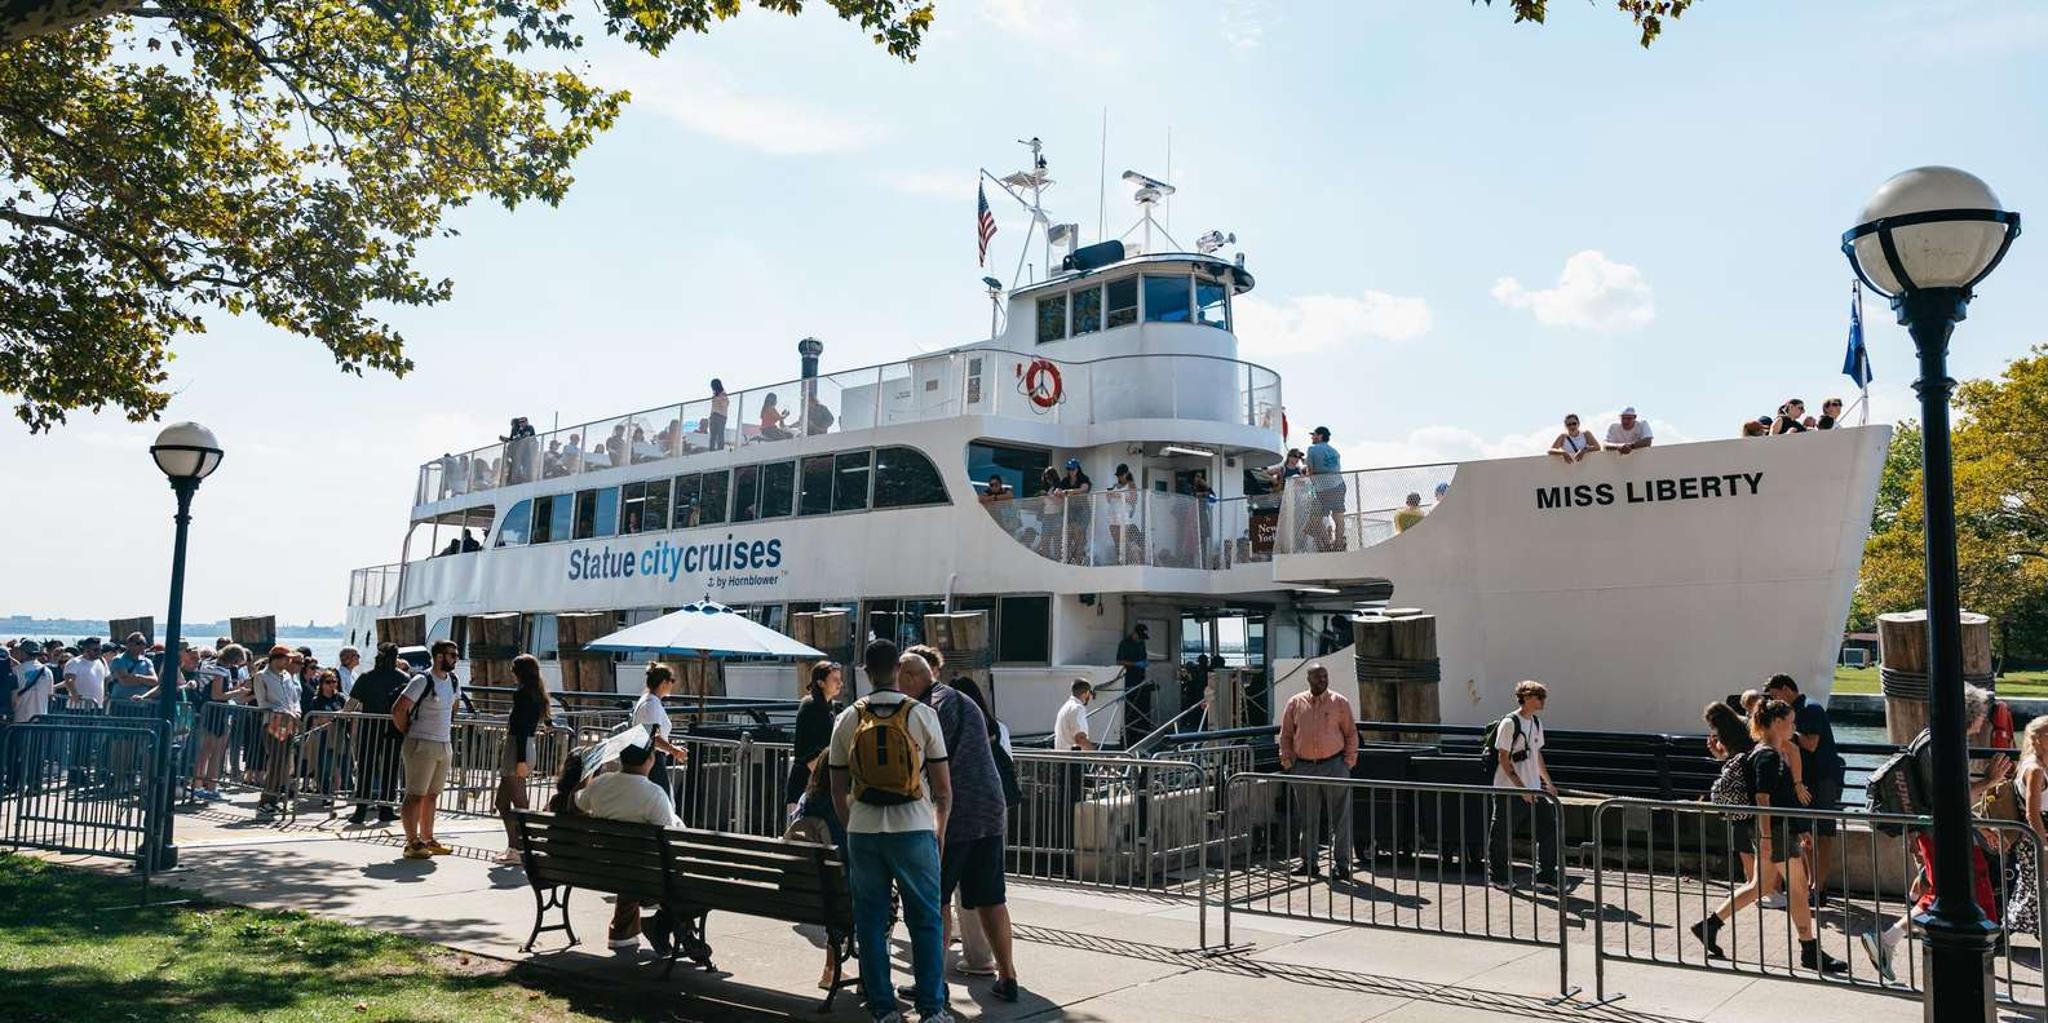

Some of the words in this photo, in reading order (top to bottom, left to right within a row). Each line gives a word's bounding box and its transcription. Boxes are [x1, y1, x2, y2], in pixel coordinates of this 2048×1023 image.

[1536, 483, 1615, 509] MISS
[1626, 472, 1763, 503] LIBERTY
[568, 546, 636, 580] Statue
[717, 576, 727, 589] by
[728, 574, 779, 587] Hornblower
